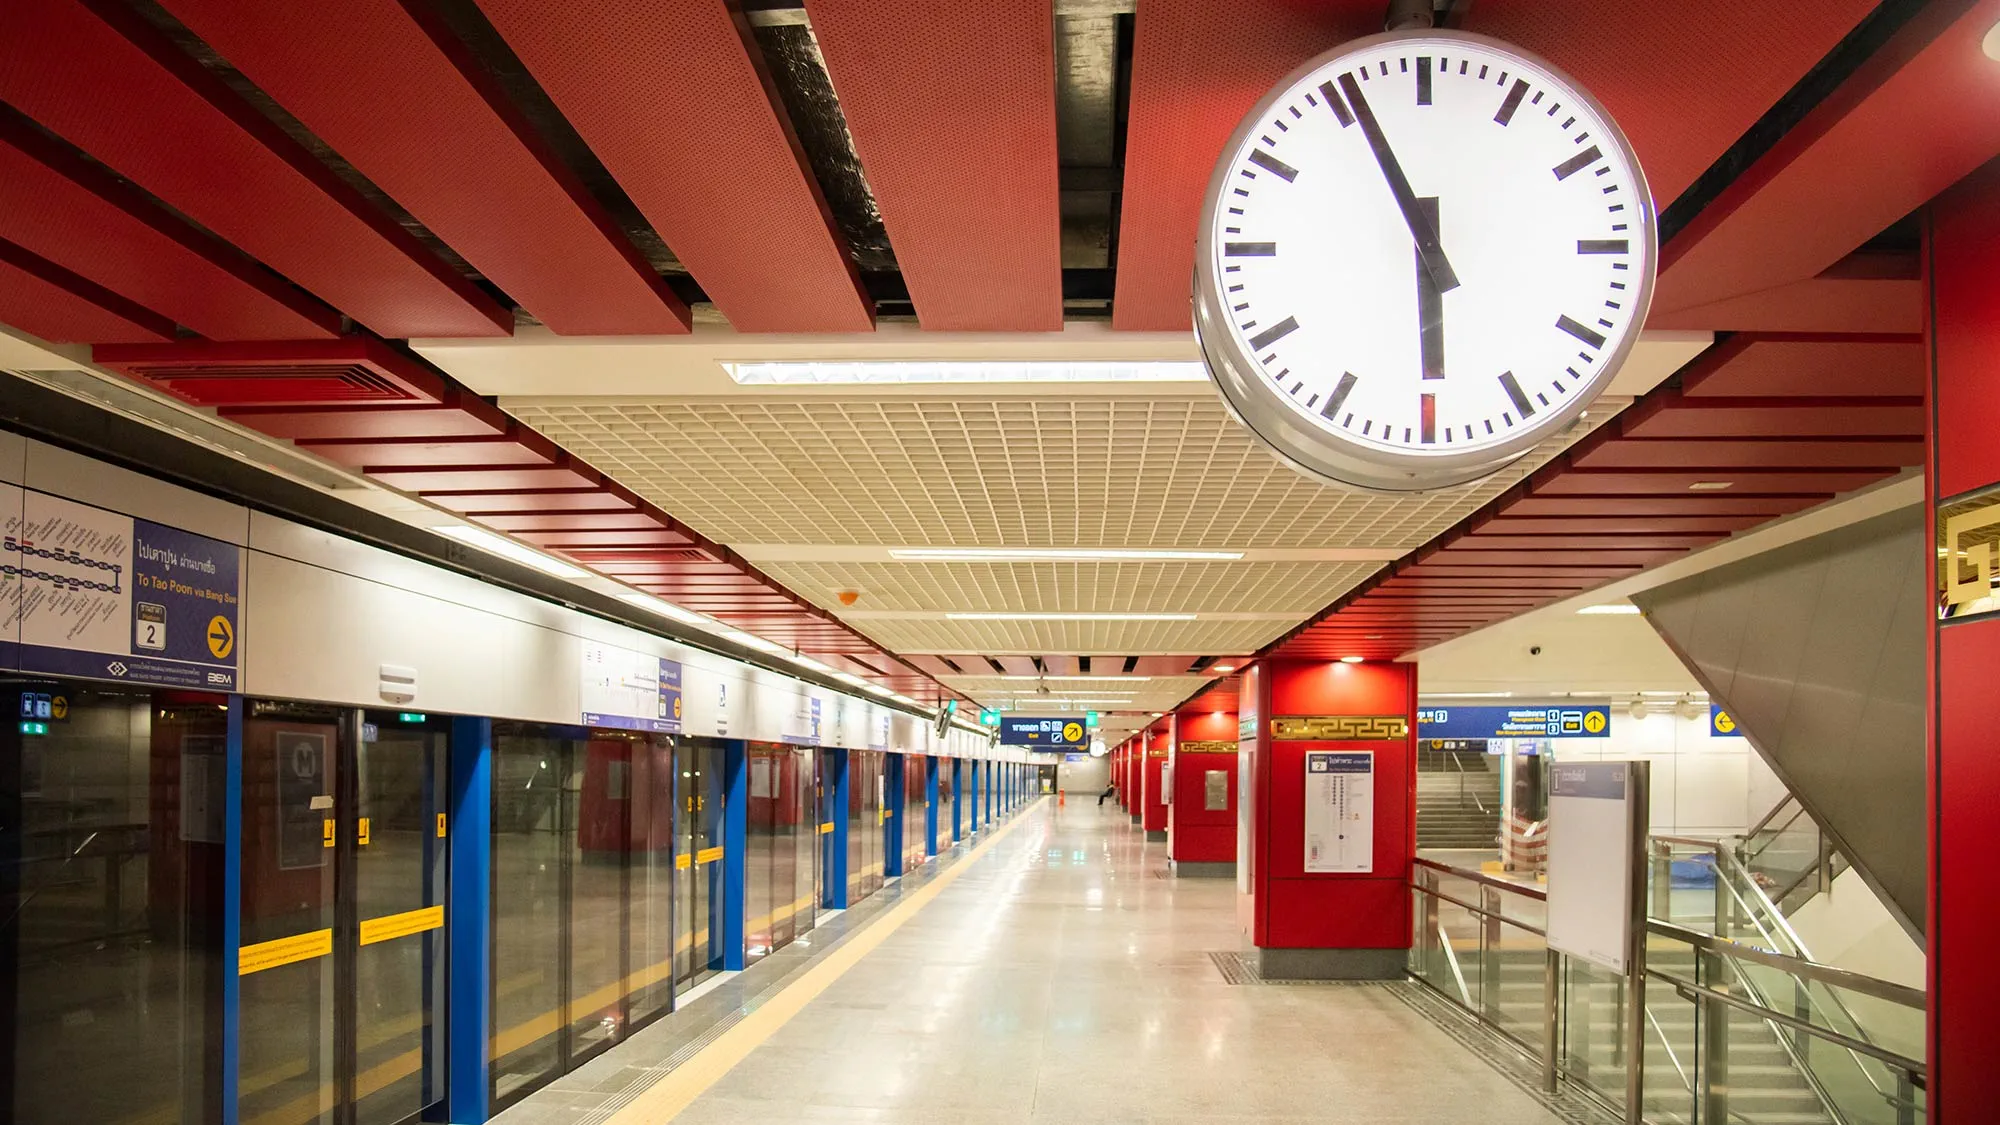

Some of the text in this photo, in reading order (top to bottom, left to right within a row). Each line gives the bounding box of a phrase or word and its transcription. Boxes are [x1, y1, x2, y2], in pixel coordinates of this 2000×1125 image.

[137, 539, 177, 571] ไปเตาปูน
[137, 573, 149, 586] To
[152, 576, 168, 590] Tao
[169, 580, 193, 595] Poon
[194, 589, 205, 598] via
[206, 589, 223, 603] Bang
[146, 625, 155, 644] 2
[207, 672, 232, 684] BEM
